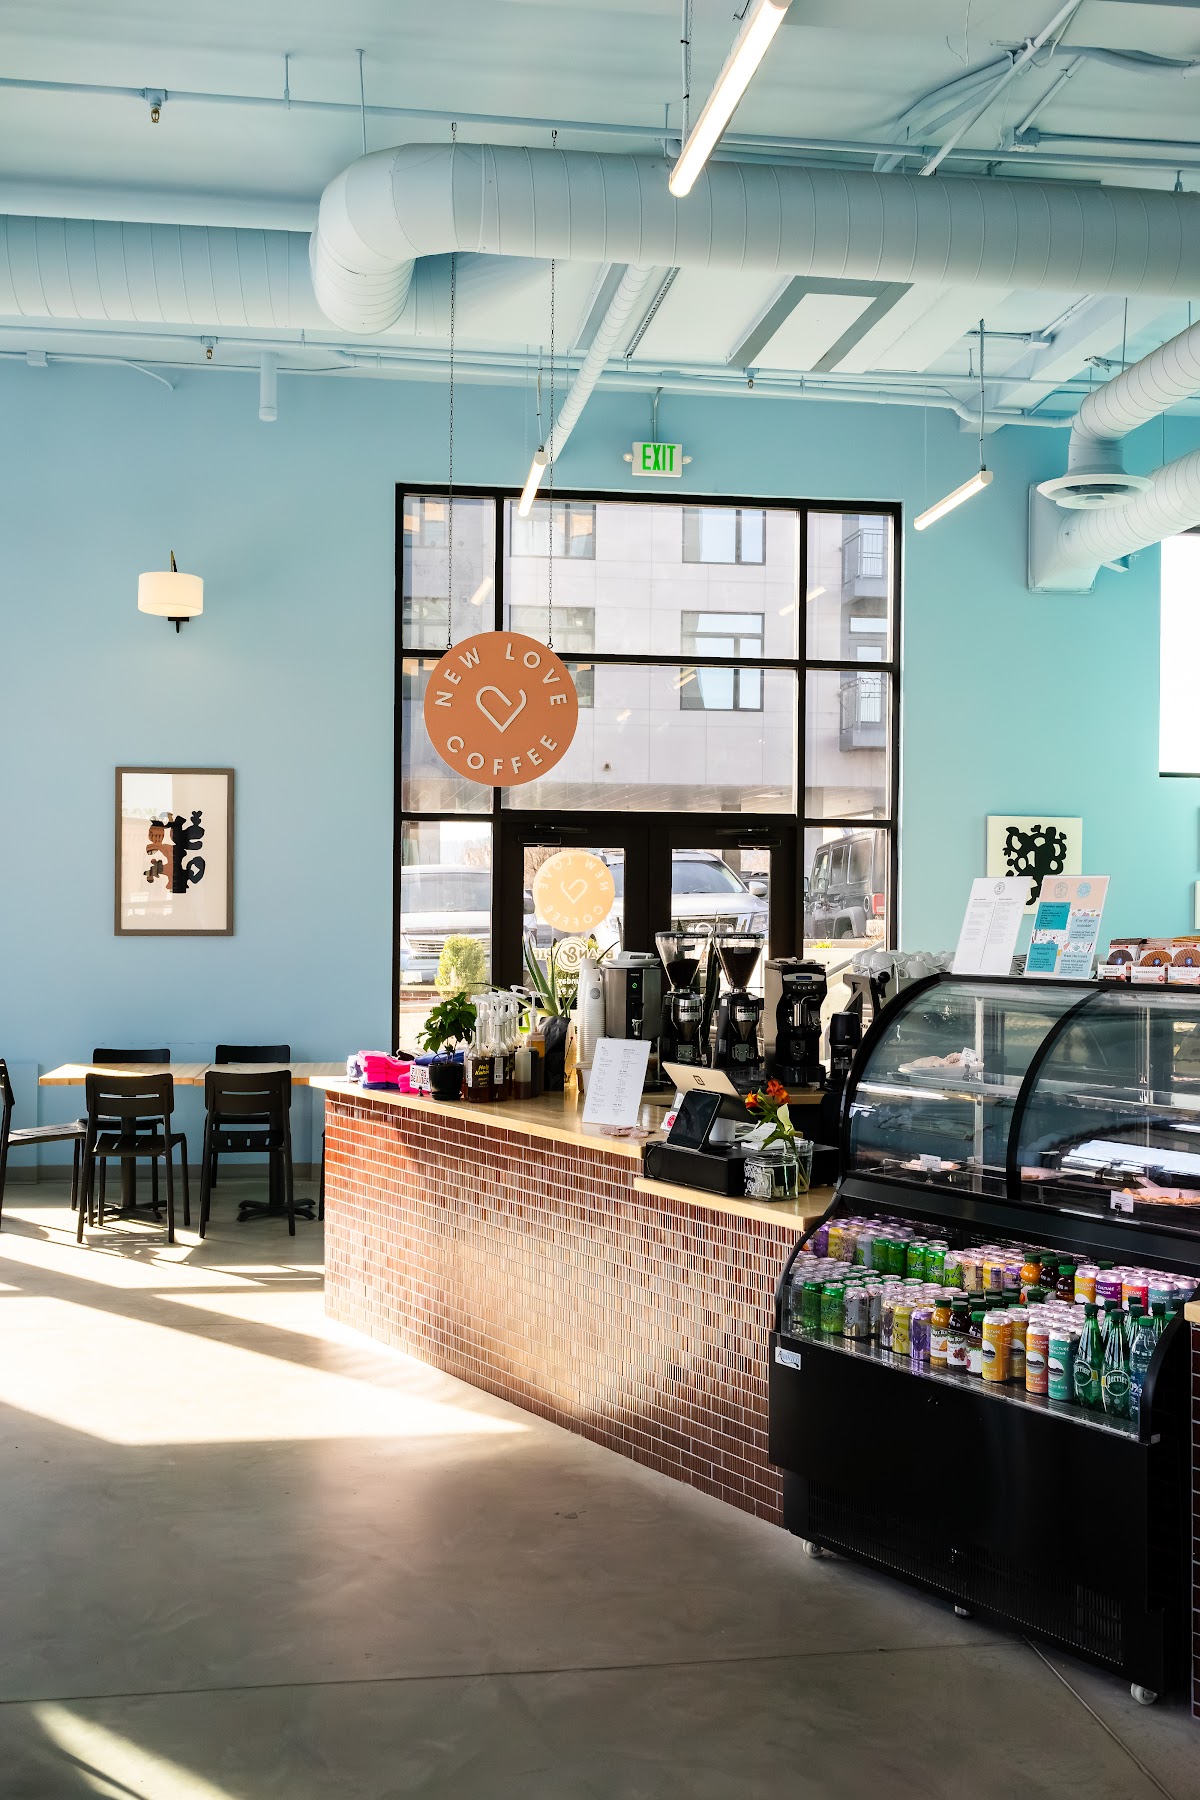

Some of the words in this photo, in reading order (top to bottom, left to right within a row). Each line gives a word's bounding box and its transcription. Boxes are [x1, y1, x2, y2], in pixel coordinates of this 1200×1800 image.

[642, 443, 676, 471] EXIT
[434, 647, 481, 707] NEW
[505, 643, 568, 705] LOVE
[446, 734, 558, 776] COFFEE
